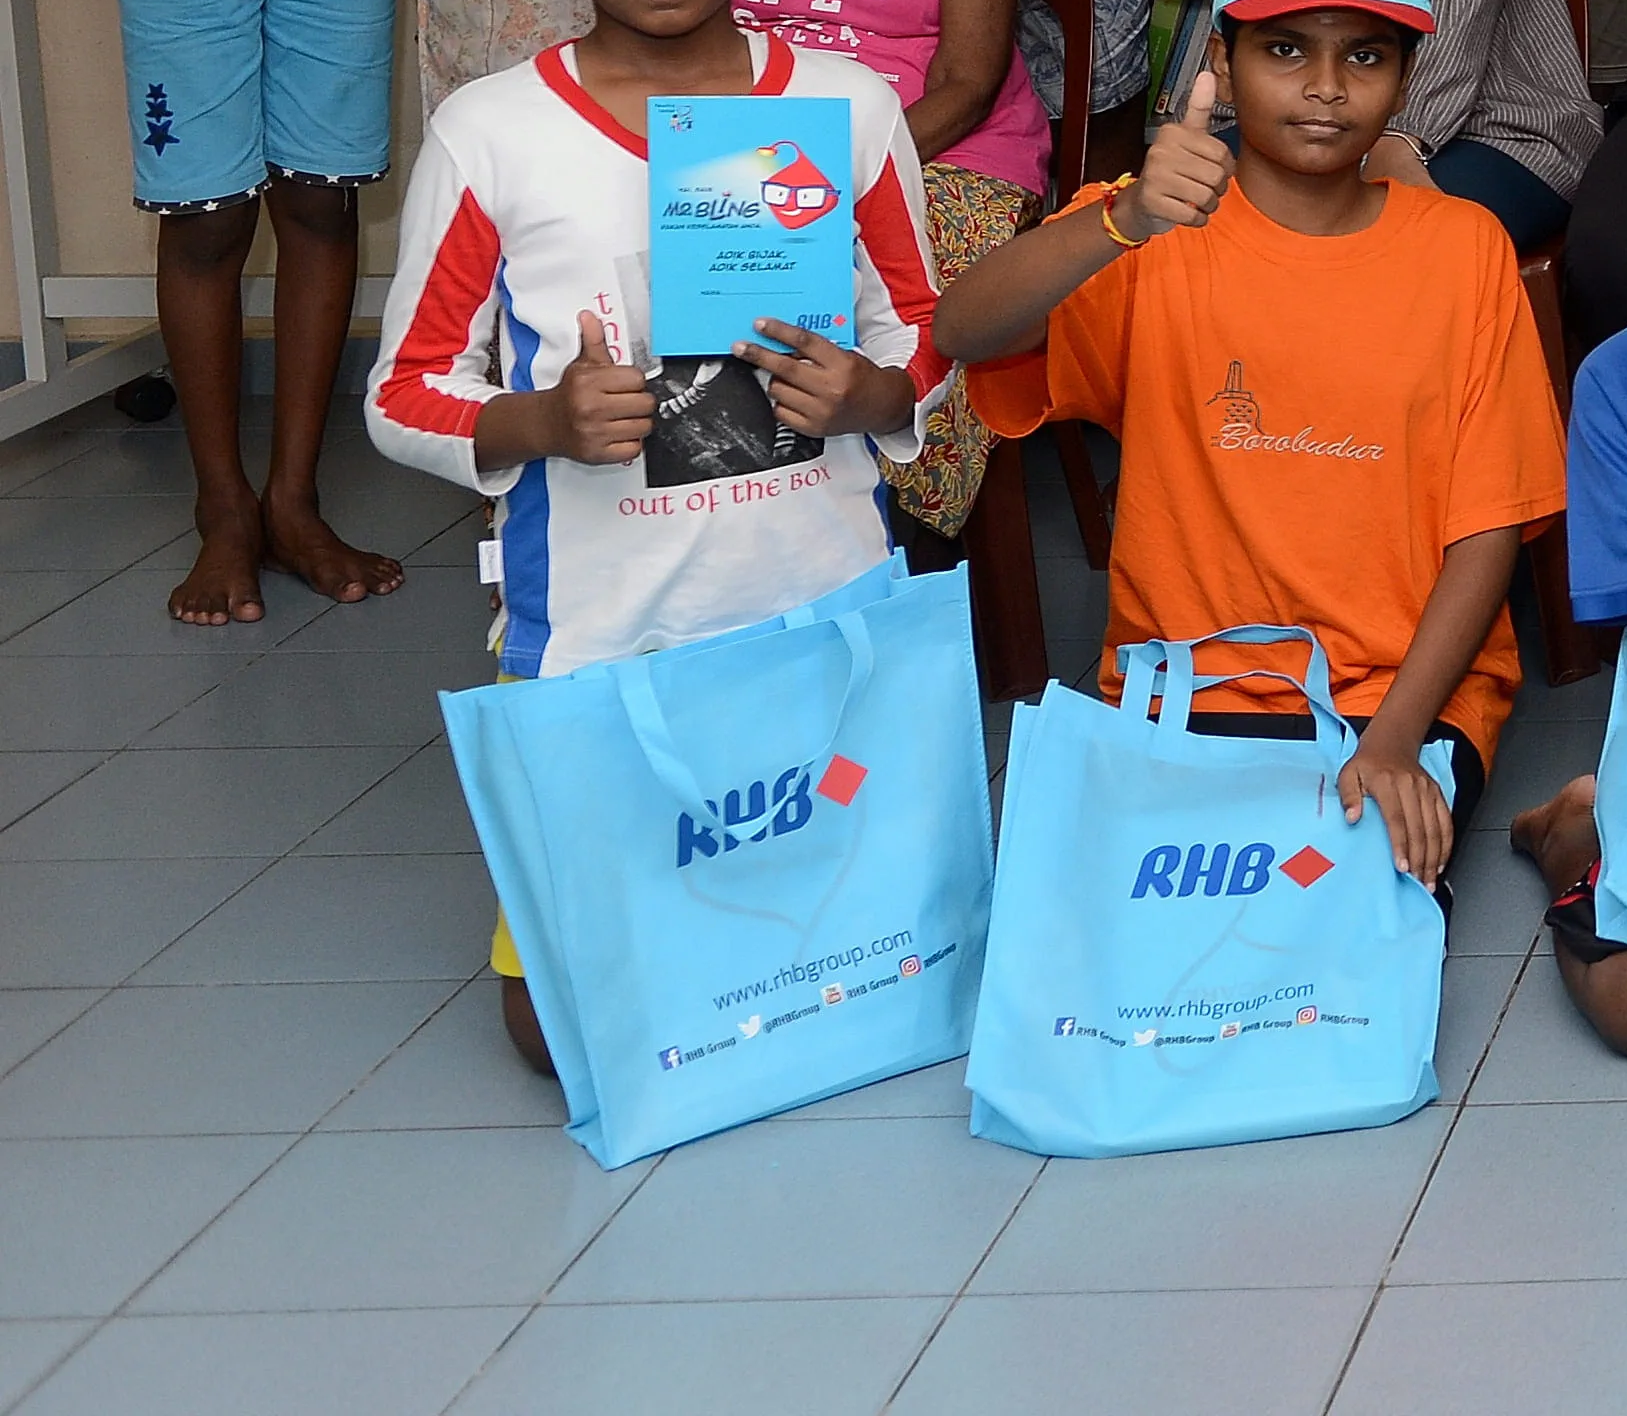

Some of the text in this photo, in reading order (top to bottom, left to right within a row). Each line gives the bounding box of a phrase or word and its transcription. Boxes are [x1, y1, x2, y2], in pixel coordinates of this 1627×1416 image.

[694, 193, 761, 221] BLING
[708, 261, 796, 272] ADIK SELAMAT
[716, 250, 746, 260] ADIK
[796, 314, 832, 330] RHB
[1218, 423, 1386, 462] Borobudur
[619, 474, 780, 517] out of the
[1130, 842, 1276, 900] RHB
[712, 928, 913, 1012] www.rhbgroup.com
[869, 973, 899, 992] Group
[1117, 983, 1315, 1021] www.rhbgroup.com
[1321, 1013, 1370, 1026] RHBGroup
